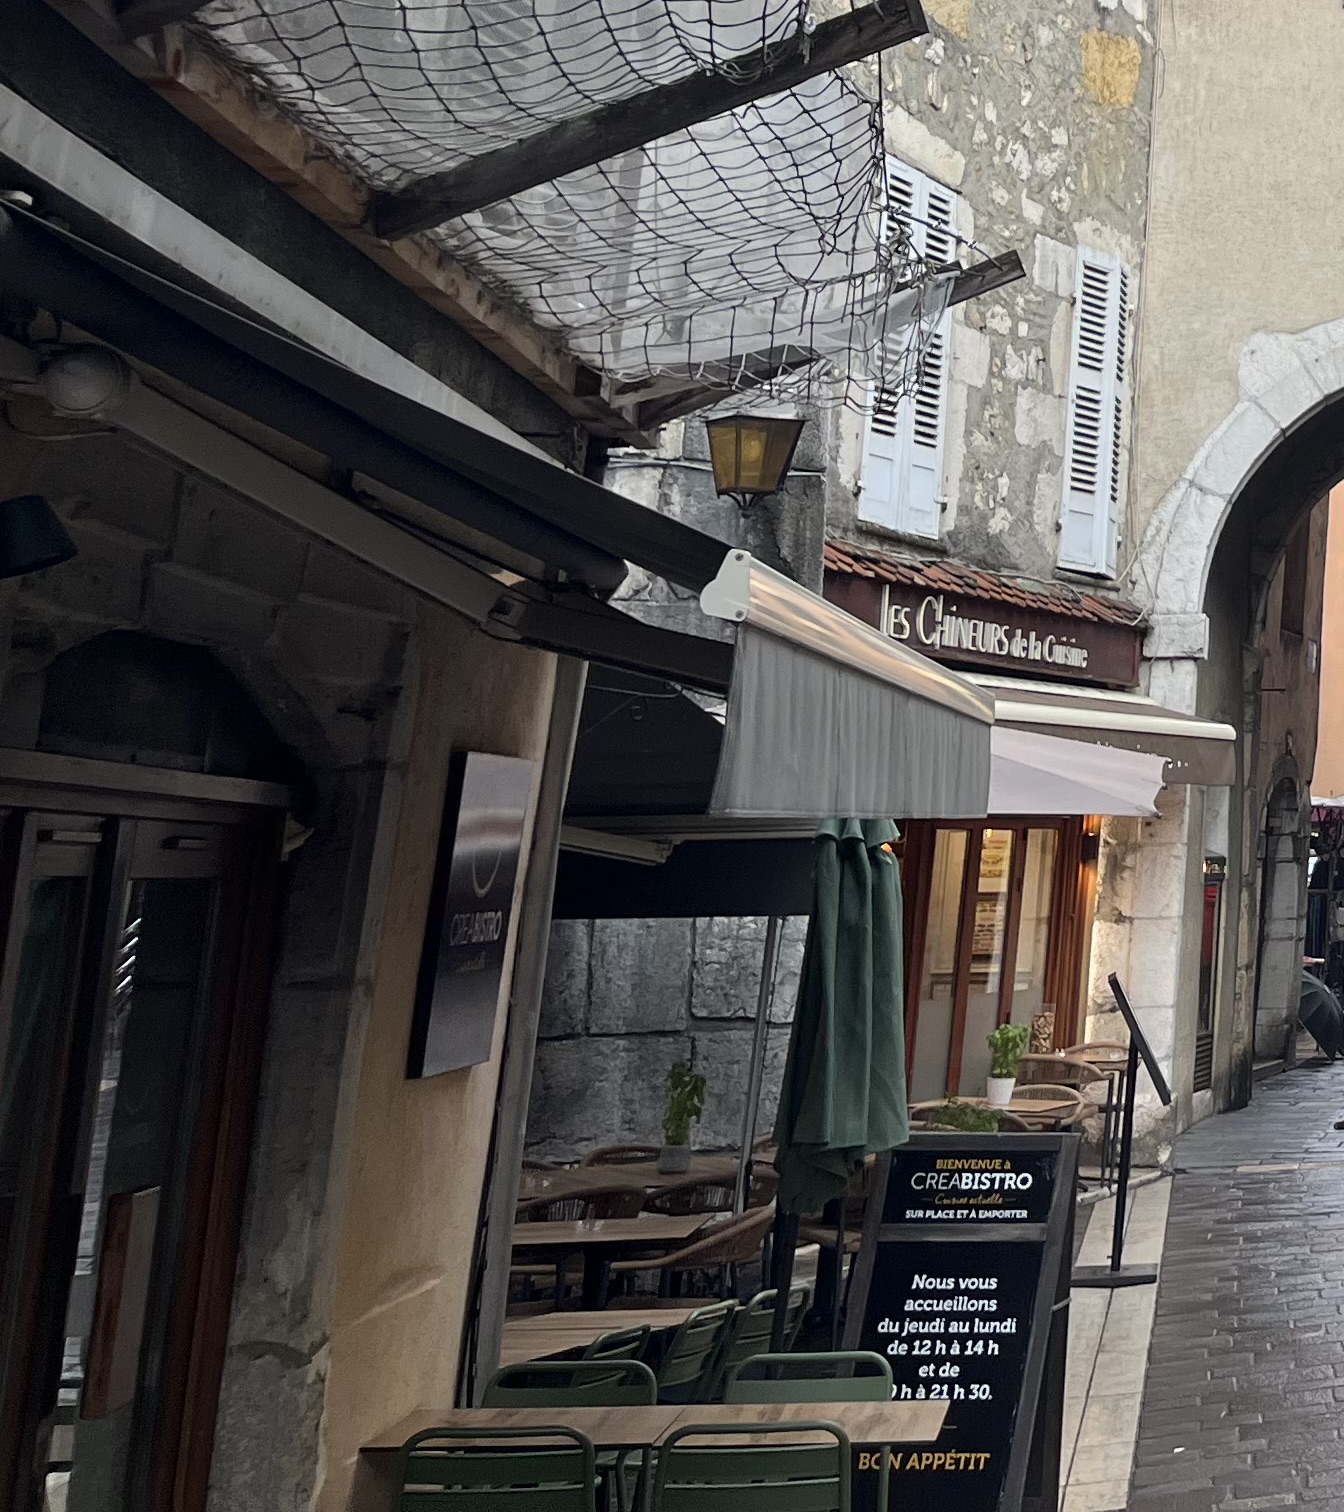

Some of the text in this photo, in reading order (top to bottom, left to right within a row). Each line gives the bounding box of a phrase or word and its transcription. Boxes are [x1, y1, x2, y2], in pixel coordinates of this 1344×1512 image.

[1010, 628, 1028, 659] de
[1028, 630, 1042, 661] la
[1043, 634, 1089, 668] Cuisine
[936, 1158, 1003, 1170] BIENVENUE
[911, 1172, 1033, 1190] CREABISTRO
[905, 1207, 1028, 1219] SUR PLACE ET À EMPORTER
[911, 1274, 998, 1290] Nous vous
[904, 1296, 998, 1311] accueillons
[877, 1318, 1017, 1337] du jeudi au lundi
[887, 1340, 999, 1355] de 12 h à 14 h
[918, 1362, 960, 1378] et de
[900, 1384, 912, 1400] h
[915, 1384, 926, 1400] à
[929, 1384, 950, 1400] 21
[953, 1384, 965, 1400] h
[968, 1384, 993, 1401] 30.
[906, 1449, 991, 1471] APPÉTIT
